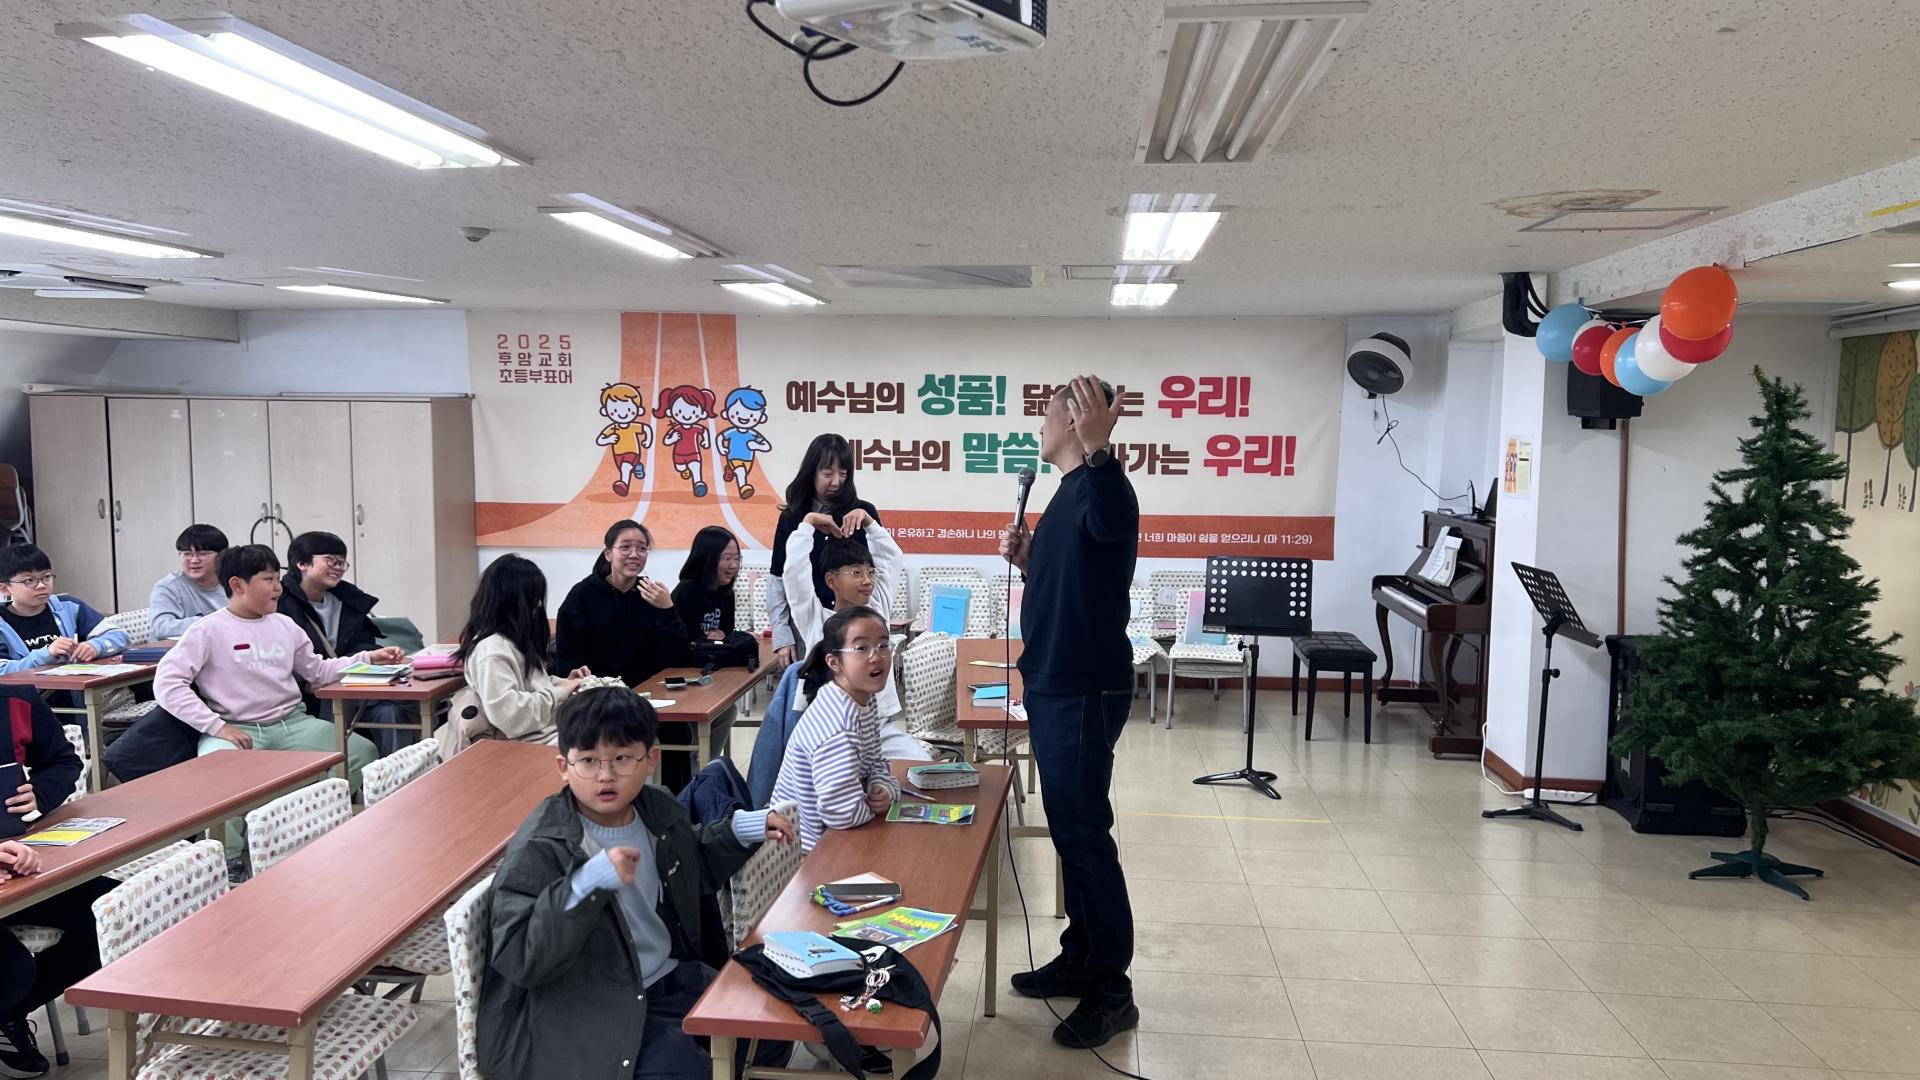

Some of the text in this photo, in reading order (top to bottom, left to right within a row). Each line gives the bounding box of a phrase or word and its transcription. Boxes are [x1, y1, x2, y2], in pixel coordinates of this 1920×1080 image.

[497, 334, 571, 350] 2025
[498, 352, 572, 367] 후암교회
[500, 369, 573, 384] 초등부표어
[786, 374, 1251, 418] 예수님의 성품! 닮는 우리!
[1204, 434, 1297, 477] 우리!
[897, 527, 935, 538] 온유하고
[937, 528, 975, 539] 겸손하니
[977, 529, 996, 540] 나의
[1144, 532, 1164, 543] 너희
[1167, 532, 1196, 543] 마음이
[1199, 532, 1218, 544] 쉼을
[1221, 533, 1260, 544] 얻으리니
[1263, 534, 1277, 545] (마
[1280, 534, 1313, 545] 11:29)
